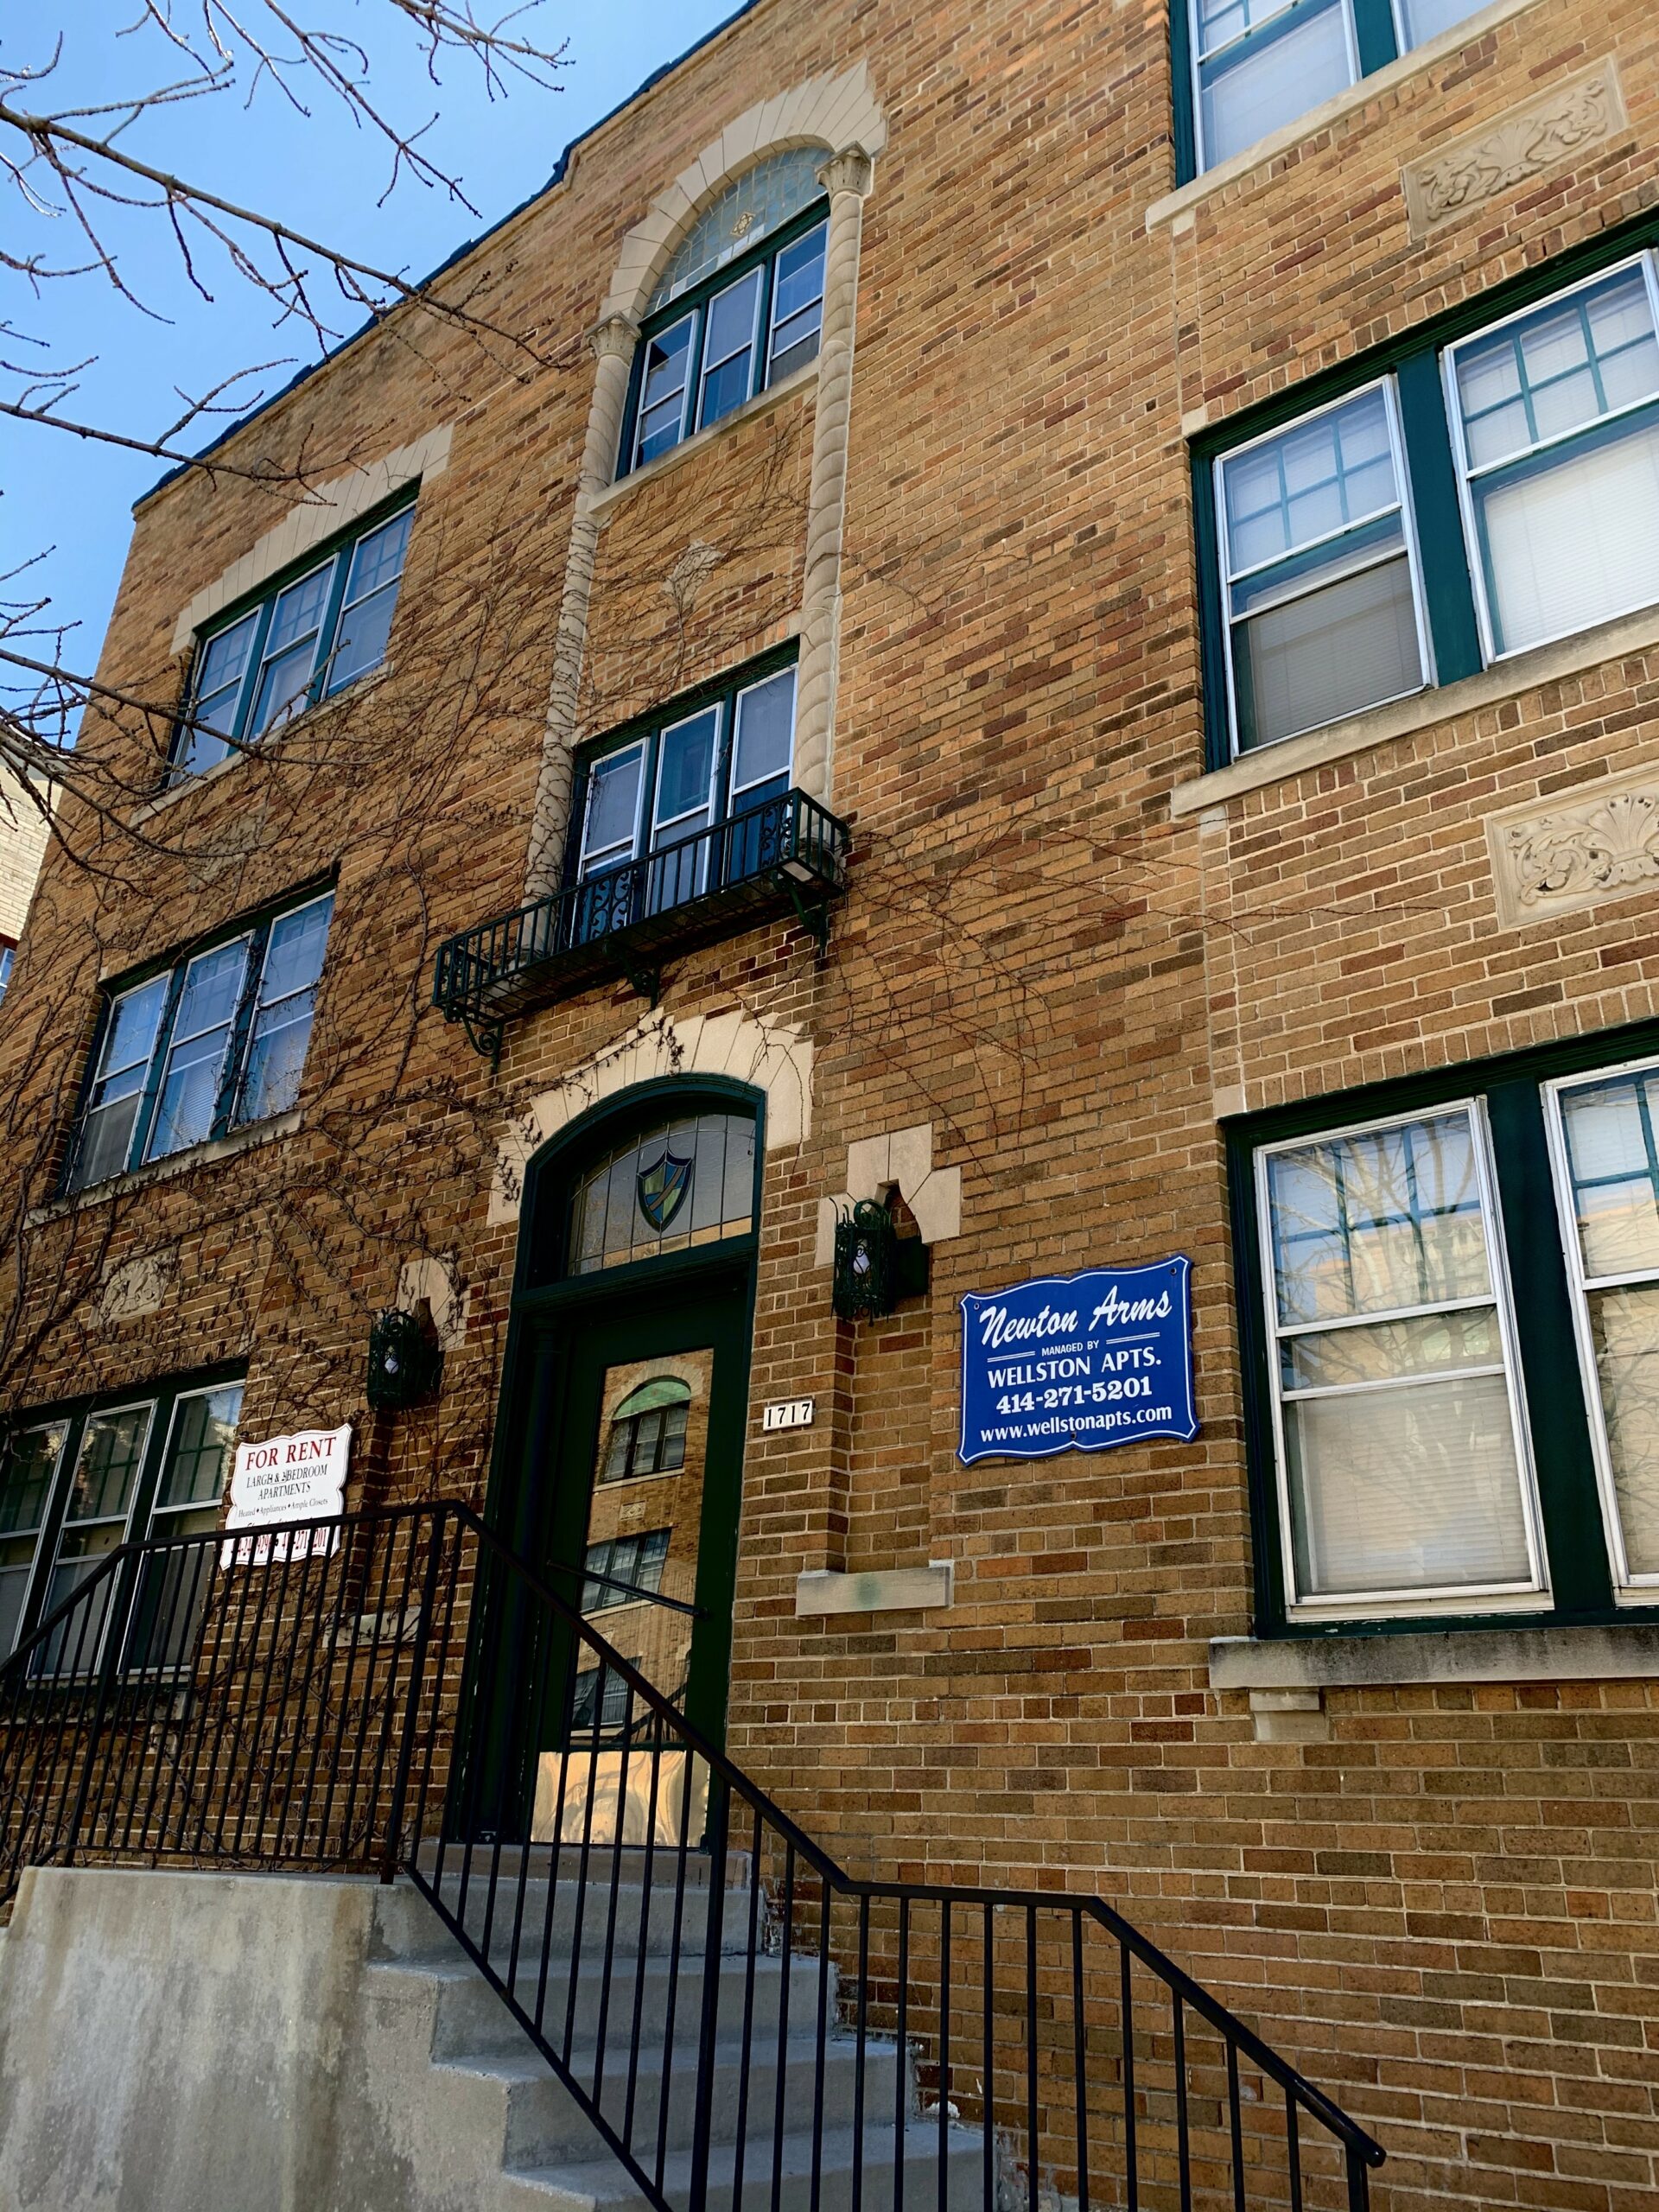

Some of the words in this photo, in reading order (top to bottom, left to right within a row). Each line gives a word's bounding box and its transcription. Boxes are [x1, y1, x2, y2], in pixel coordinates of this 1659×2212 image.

[979, 1306, 1078, 1348] Newton
[1088, 1285, 1173, 1331] Arms
[1041, 1343, 1084, 1357] MANAGED
[1087, 1340, 1099, 1350] BY
[988, 1356, 1091, 1389] WELLSTON
[1102, 1346, 1162, 1373] APTS.
[995, 1376, 1153, 1414] 414-271-5201
[767, 1402, 810, 1427] 1717
[981, 1405, 1173, 1442] www.wellstonapts.com
[245, 1447, 278, 1471] FOR
[285, 1437, 337, 1464] RENT
[238, 1508, 256, 1518] Heated
[260, 1504, 287, 1516] Appliances
[292, 1500, 308, 1510] Ample
[309, 1498, 328, 1507] Closets
[257, 1481, 311, 1501] APARTMENTS
